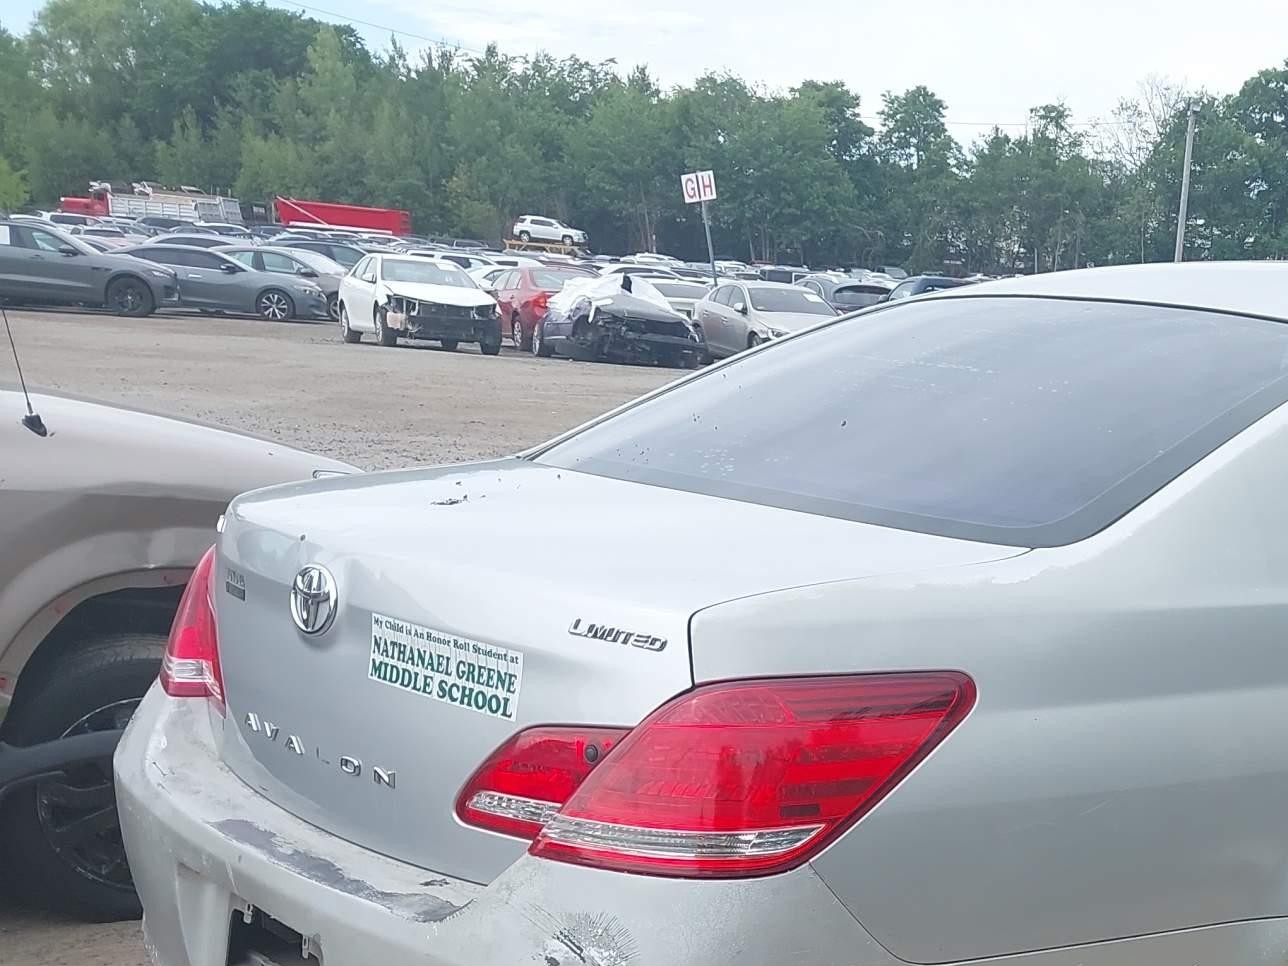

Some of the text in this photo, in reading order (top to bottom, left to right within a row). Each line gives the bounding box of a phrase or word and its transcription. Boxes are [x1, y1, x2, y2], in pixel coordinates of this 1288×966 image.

[373, 616, 383, 630] My
[384, 619, 404, 634] Child
[413, 628, 425, 640] An
[426, 631, 451, 648] Honor
[453, 638, 470, 654] Roll
[472, 643, 508, 662] Student
[509, 653, 519, 665] at
[568, 618, 668, 652] LIMITED
[370, 658, 513, 719] MIDDLE SCHOOL
[371, 634, 518, 695] NATHANAEL GREENE
